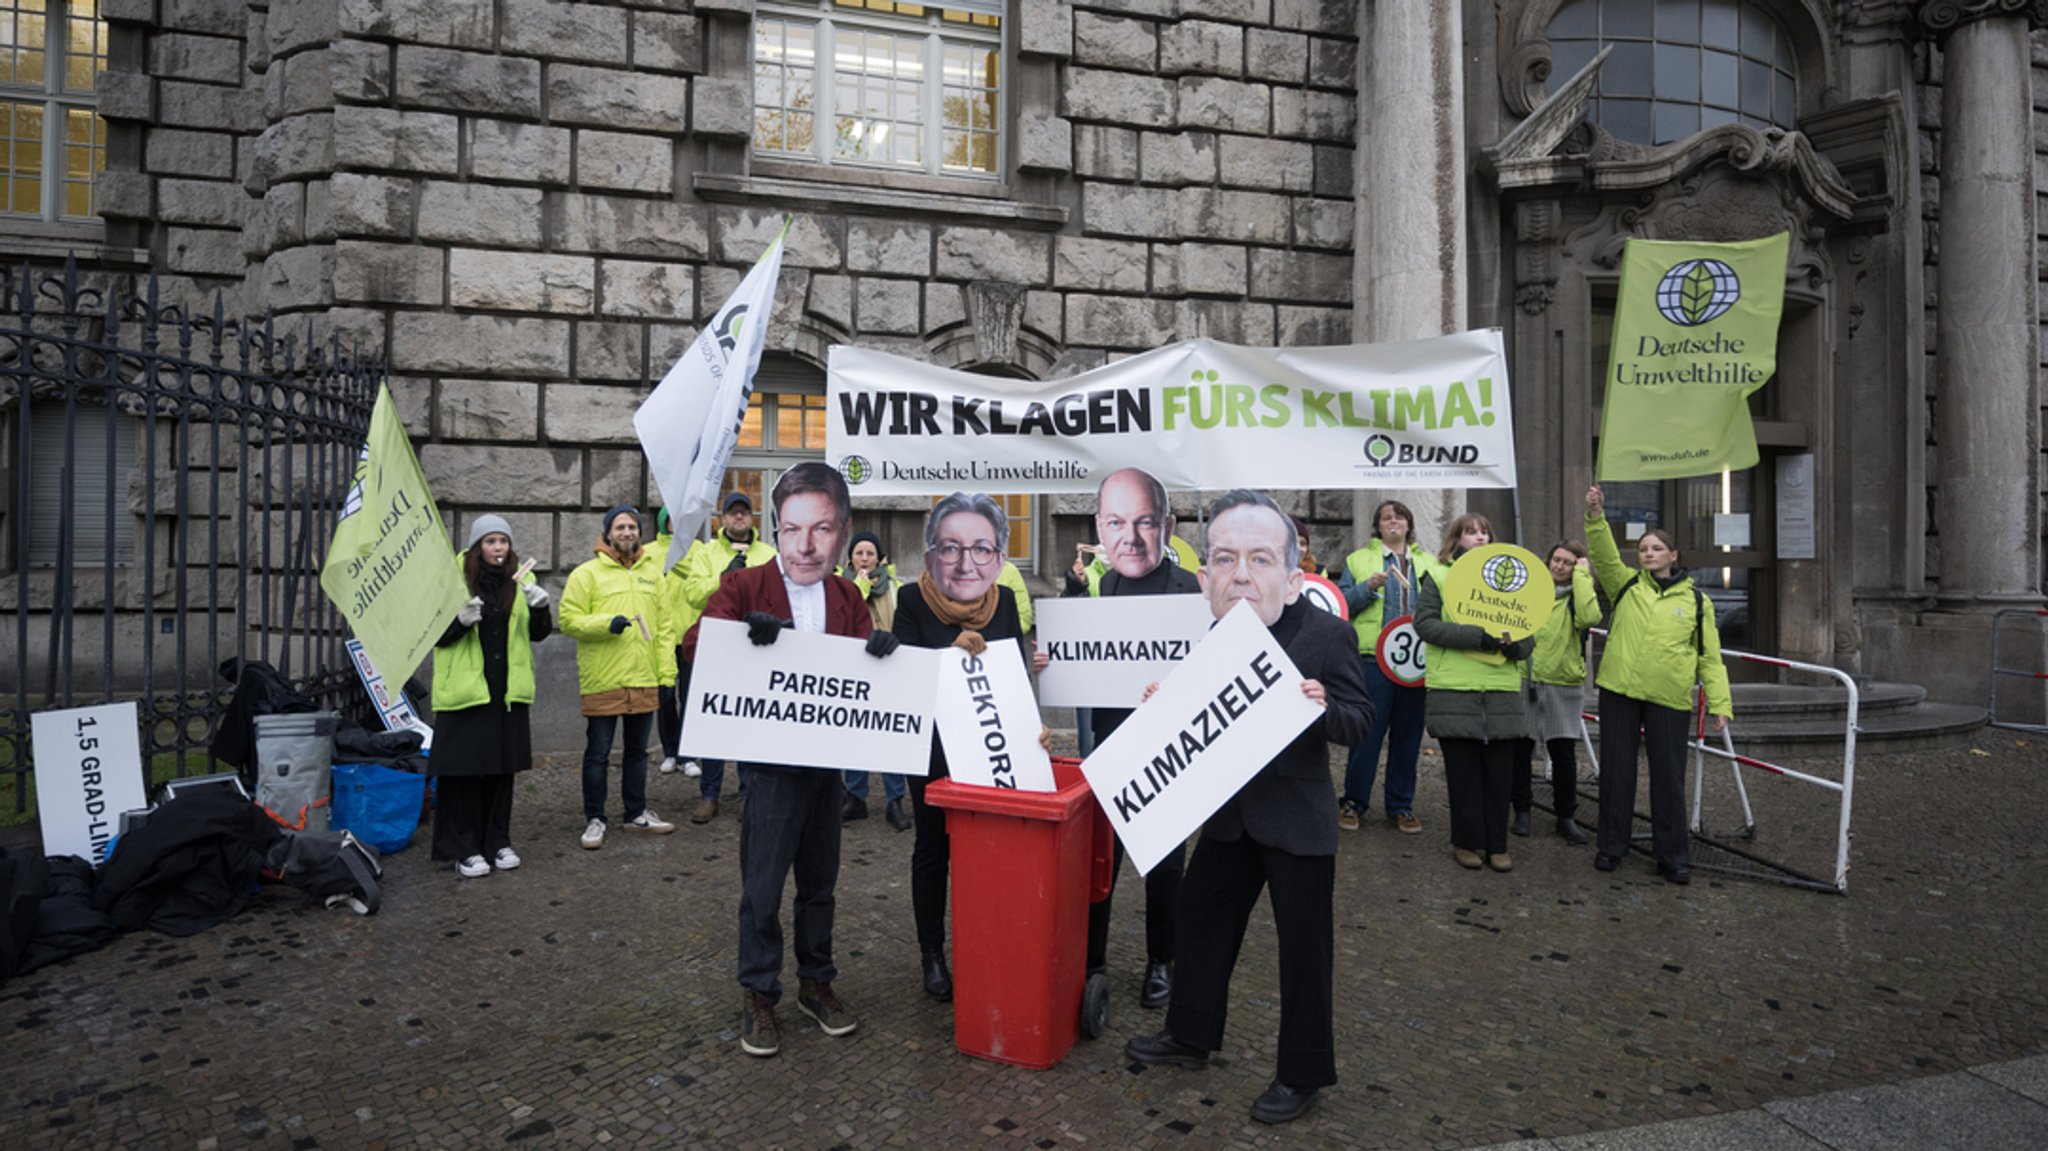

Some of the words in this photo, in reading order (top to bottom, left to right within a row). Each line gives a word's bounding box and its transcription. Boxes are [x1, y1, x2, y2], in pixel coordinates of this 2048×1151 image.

[1637, 331, 1746, 358] Deutsche
[1616, 362, 1764, 385] Umwelthilfe
[839, 391, 942, 436] WIR
[952, 387, 1150, 437] KLAGEN
[1162, 369, 1291, 431] FÜRS
[1302, 377, 1496, 431] KLIMA!
[1398, 443, 1479, 464] BUND
[882, 460, 969, 481] Deutsche
[971, 459, 1088, 480] Umwelthilfe
[1470, 588, 1528, 613] Deutsche
[1457, 601, 1533, 631] Umwelthilfe
[768, 670, 871, 701] PARISER
[701, 692, 922, 734] KLIMAABKOMMEN
[74, 716, 99, 751] 1,5
[1112, 650, 1284, 823] KLIMAZIELE
[80, 756, 109, 868] GRAD-LIM
